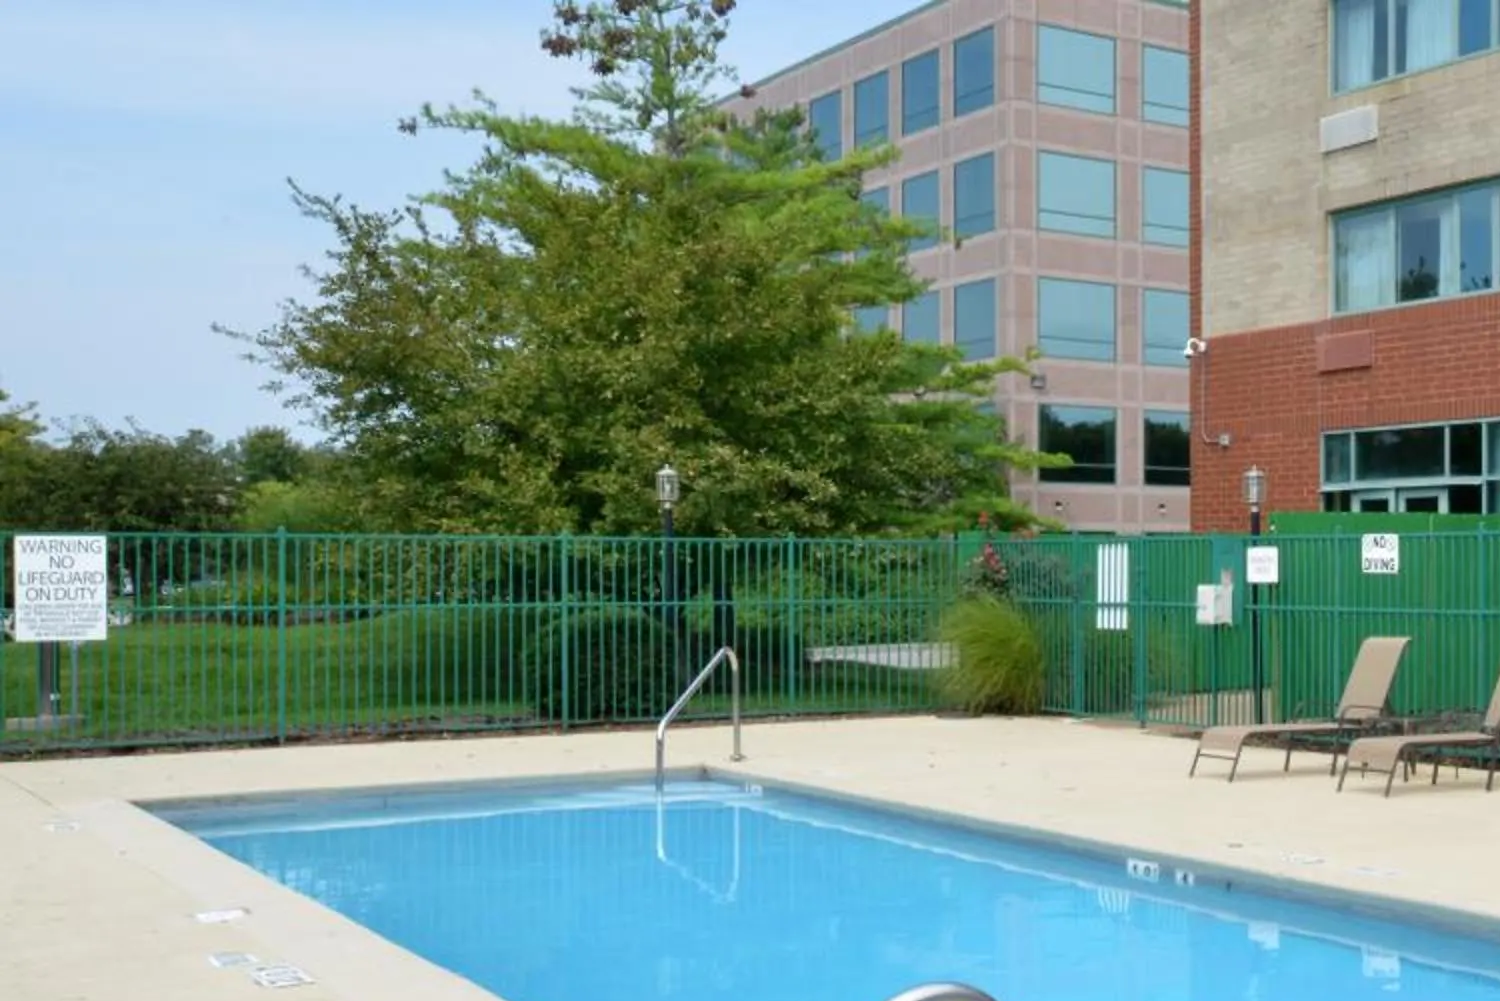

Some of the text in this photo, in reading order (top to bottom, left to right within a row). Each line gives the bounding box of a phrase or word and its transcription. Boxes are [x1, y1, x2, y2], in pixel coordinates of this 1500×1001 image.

[19, 540, 103, 554] WARNING
[1373, 536, 1386, 549] NO
[50, 556, 75, 569] NO
[1363, 558, 1396, 571] DIVING
[19, 571, 104, 585] LIFEGUARD
[26, 587, 97, 601] ON DUTY
